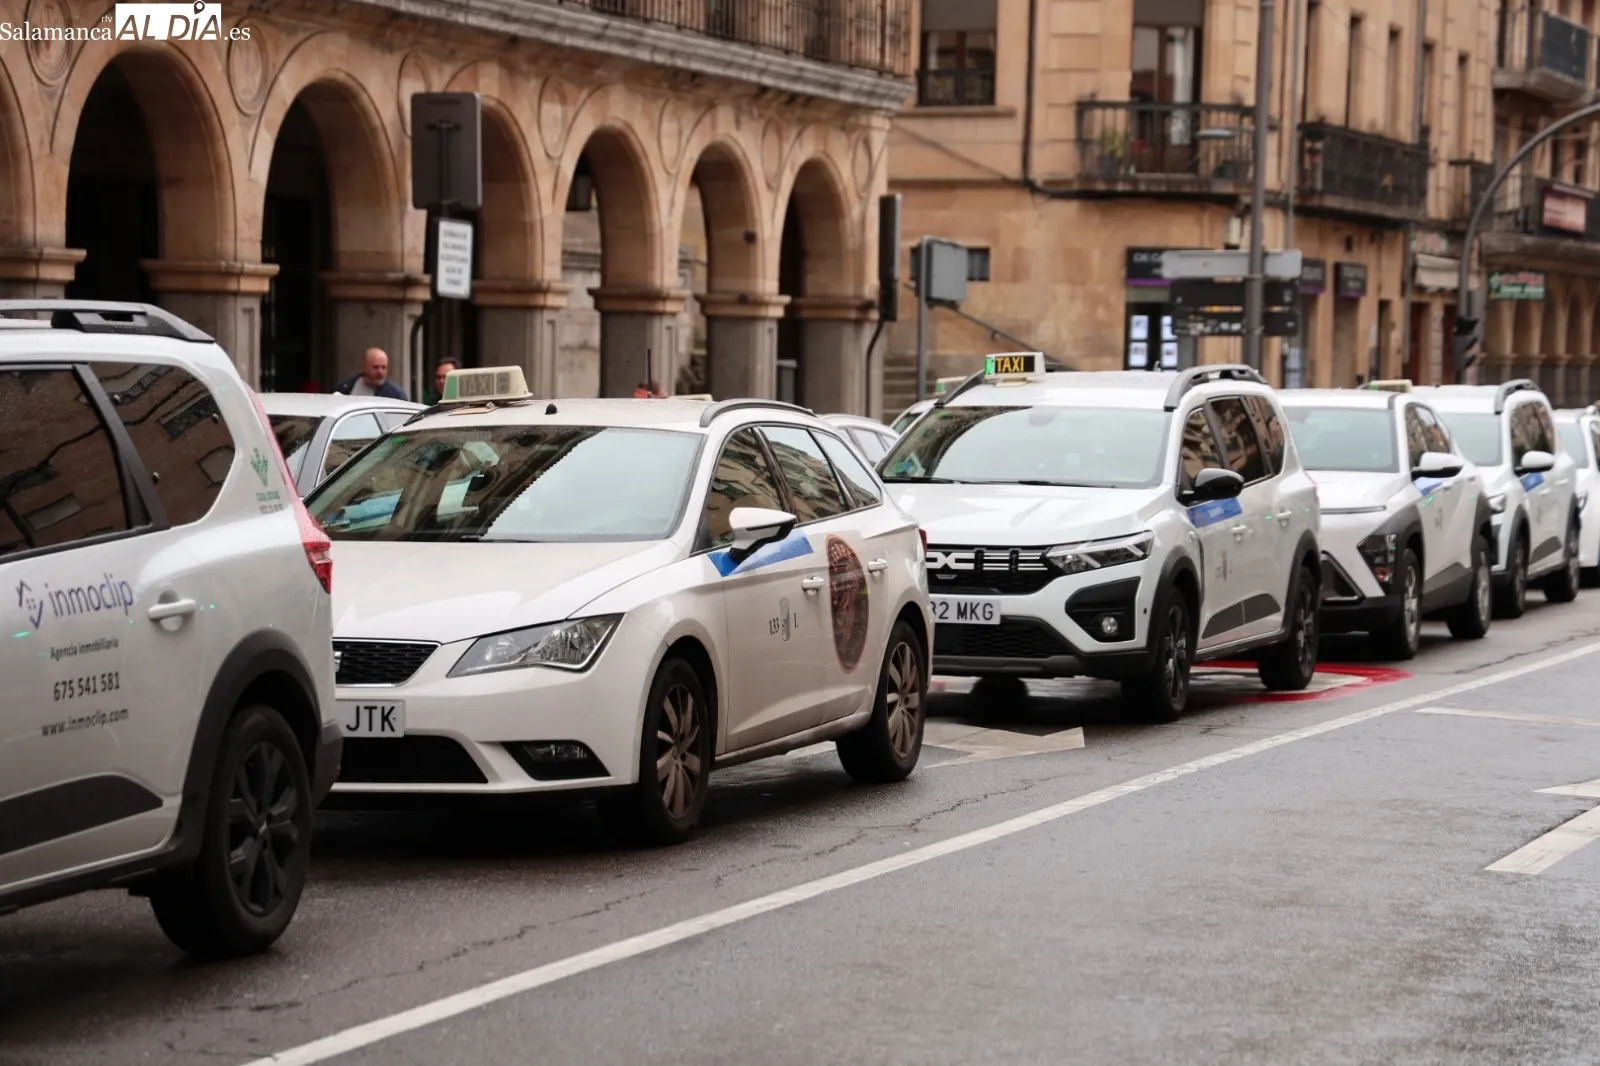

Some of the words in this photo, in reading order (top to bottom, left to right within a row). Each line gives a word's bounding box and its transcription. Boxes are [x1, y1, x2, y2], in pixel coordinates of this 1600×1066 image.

[996, 356, 1025, 373] TAXI
[460, 374, 493, 397] TAXI
[45, 572, 133, 618] inmoclip
[957, 601, 993, 621] MKG
[50, 645, 78, 662] Agencia
[79, 637, 119, 655] inmobiliaria
[54, 678, 75, 701] 675
[78, 675, 98, 697] 541
[101, 671, 121, 693] 581
[41, 708, 129, 737] www.inmoclip.com
[346, 705, 396, 732] JTK
